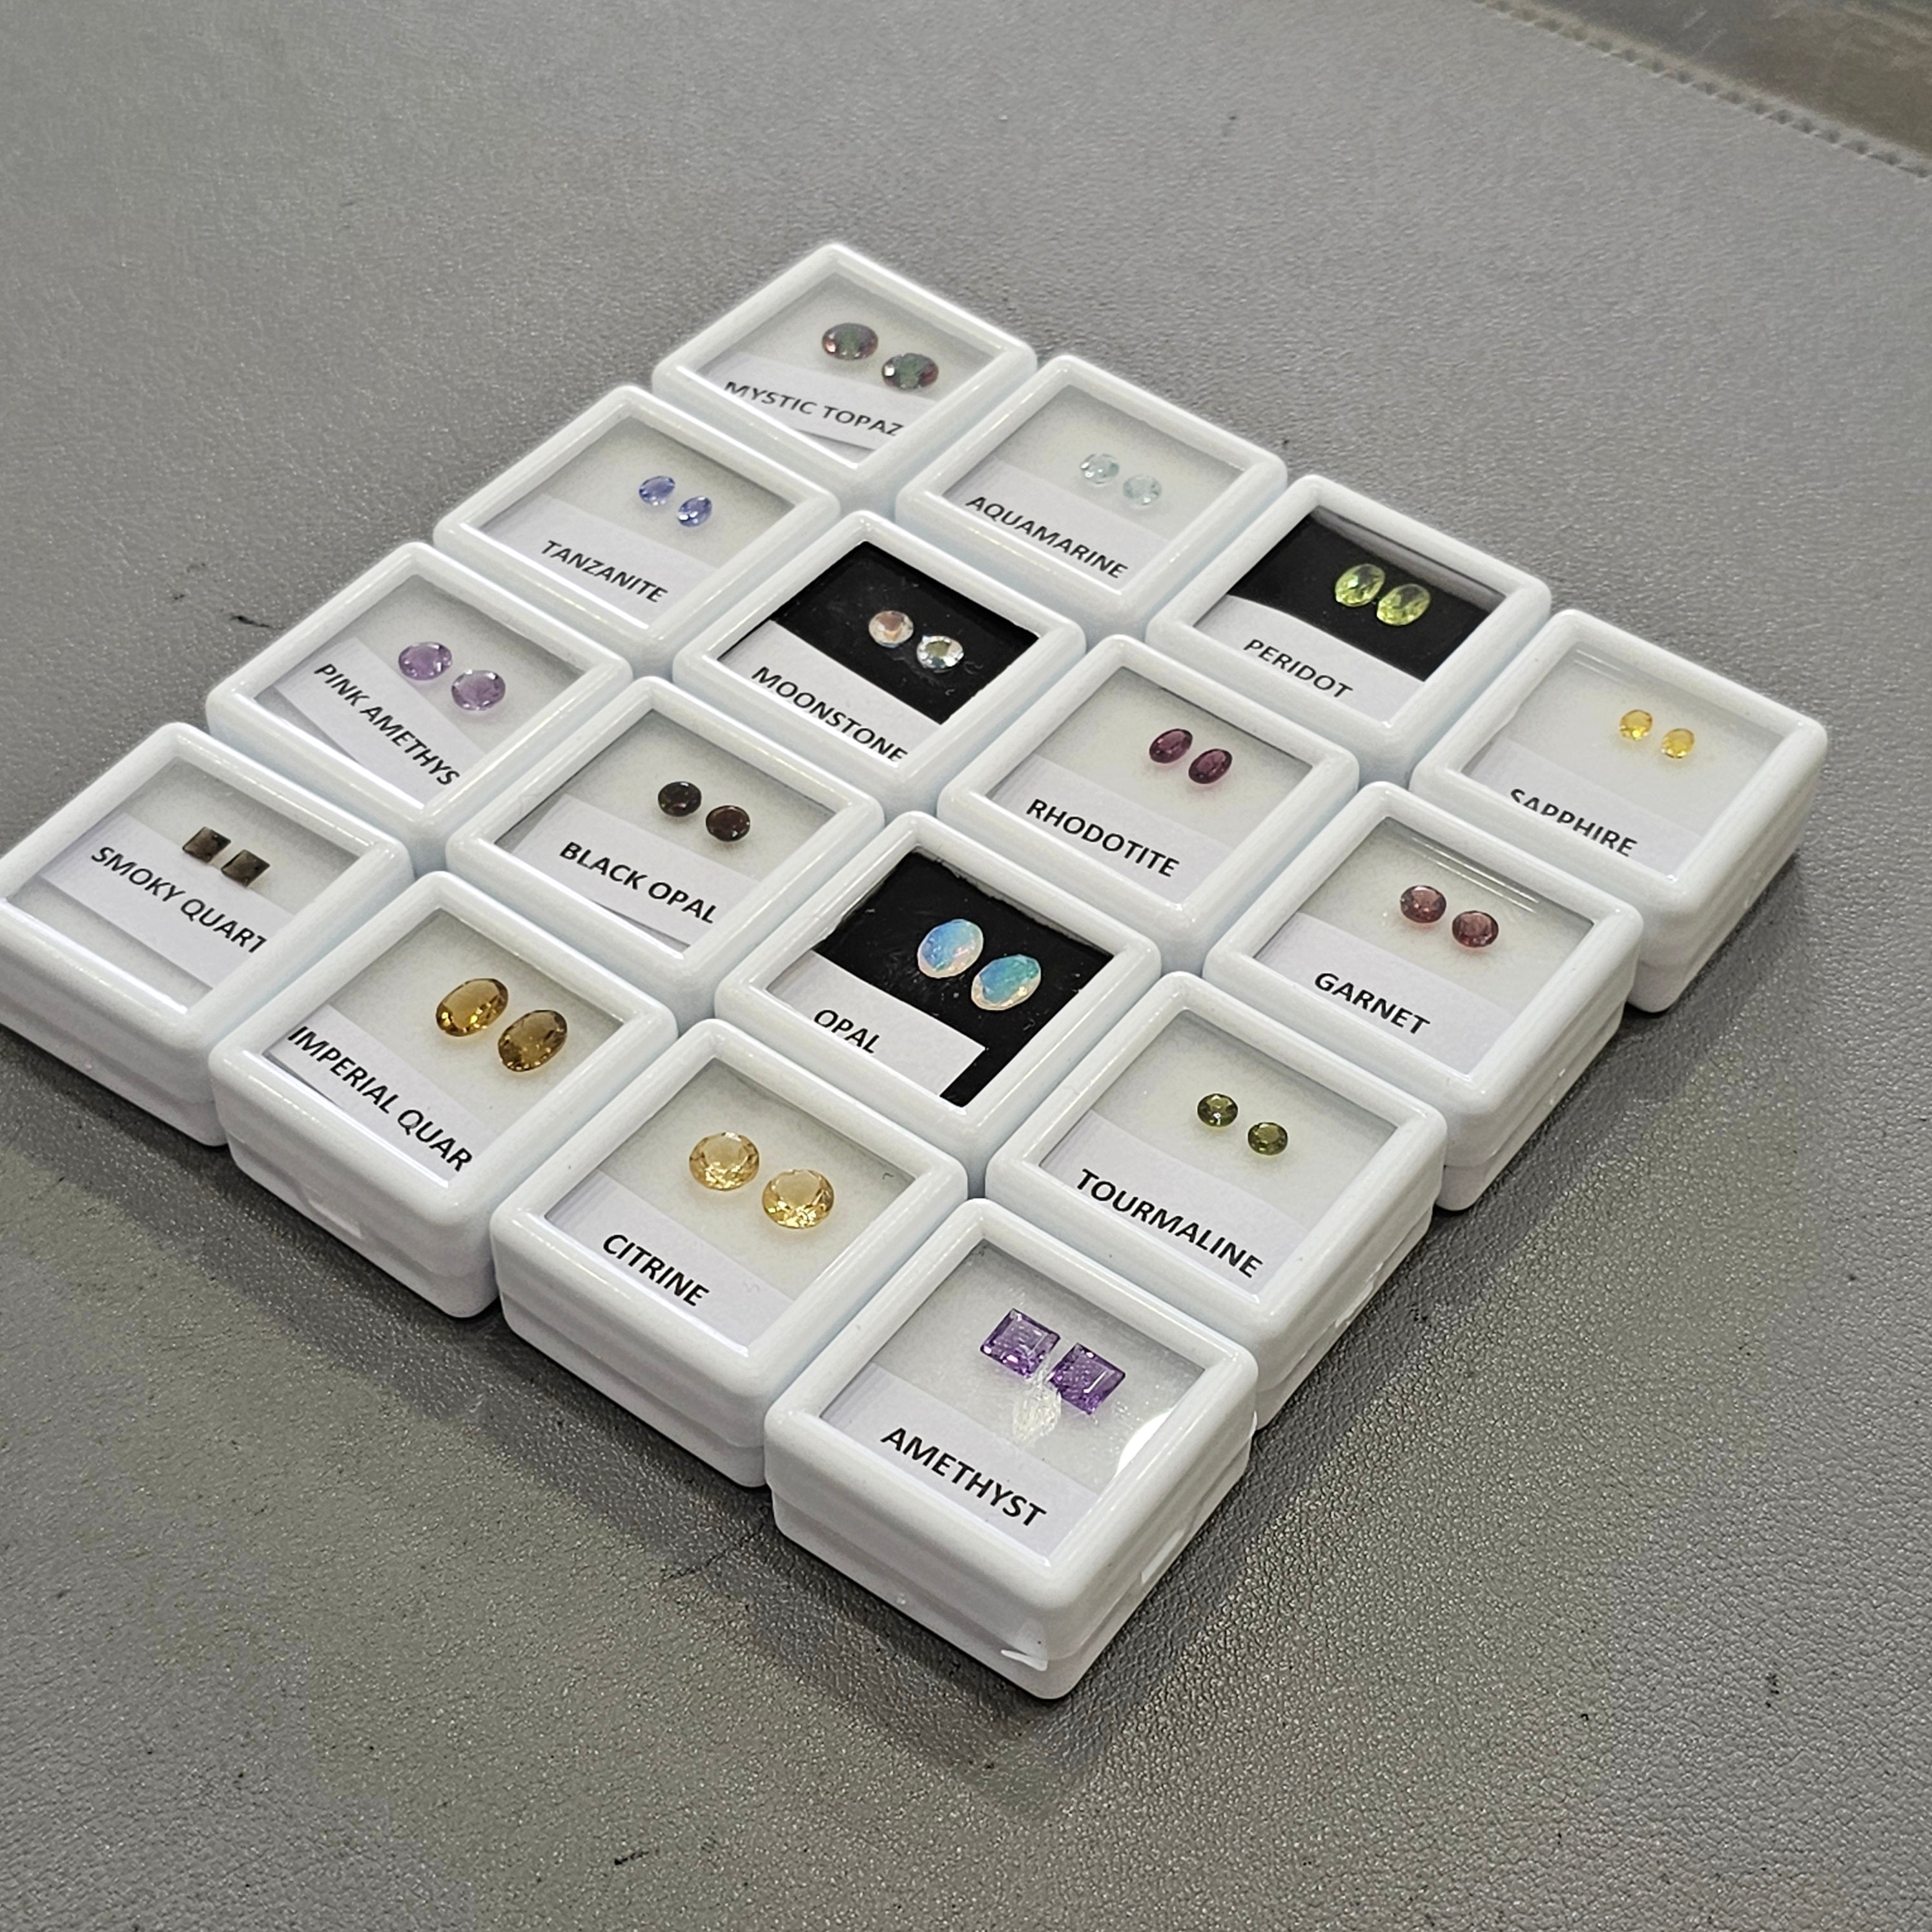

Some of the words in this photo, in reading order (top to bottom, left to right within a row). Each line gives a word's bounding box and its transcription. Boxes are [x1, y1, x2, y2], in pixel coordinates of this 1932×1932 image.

[725, 382, 815, 415] MYSTIC
[823, 406, 904, 437] TOPAZ
[542, 540, 668, 603] TANZANITE
[966, 496, 1128, 579] AQUAMARINE
[1244, 639, 1353, 698] PERIDOT
[314, 663, 371, 707] PINK
[360, 706, 460, 786] AMETHYS
[751, 666, 908, 763] MOONSTONE
[92, 847, 186, 902] SMOKY
[1027, 798, 1179, 878] RHODOTITE
[559, 842, 648, 890] BLACK
[648, 881, 717, 924] OPAL
[814, 1009, 882, 1054] OPAL
[1315, 973, 1430, 1035] GARNET
[288, 1026, 399, 1115] IMPERIAL
[398, 1109, 472, 1171] QUAR
[1076, 1169, 1263, 1279] TOURMALINE
[603, 1234, 710, 1306] CITRINE
[881, 1428, 1047, 1527] AMETHYST
